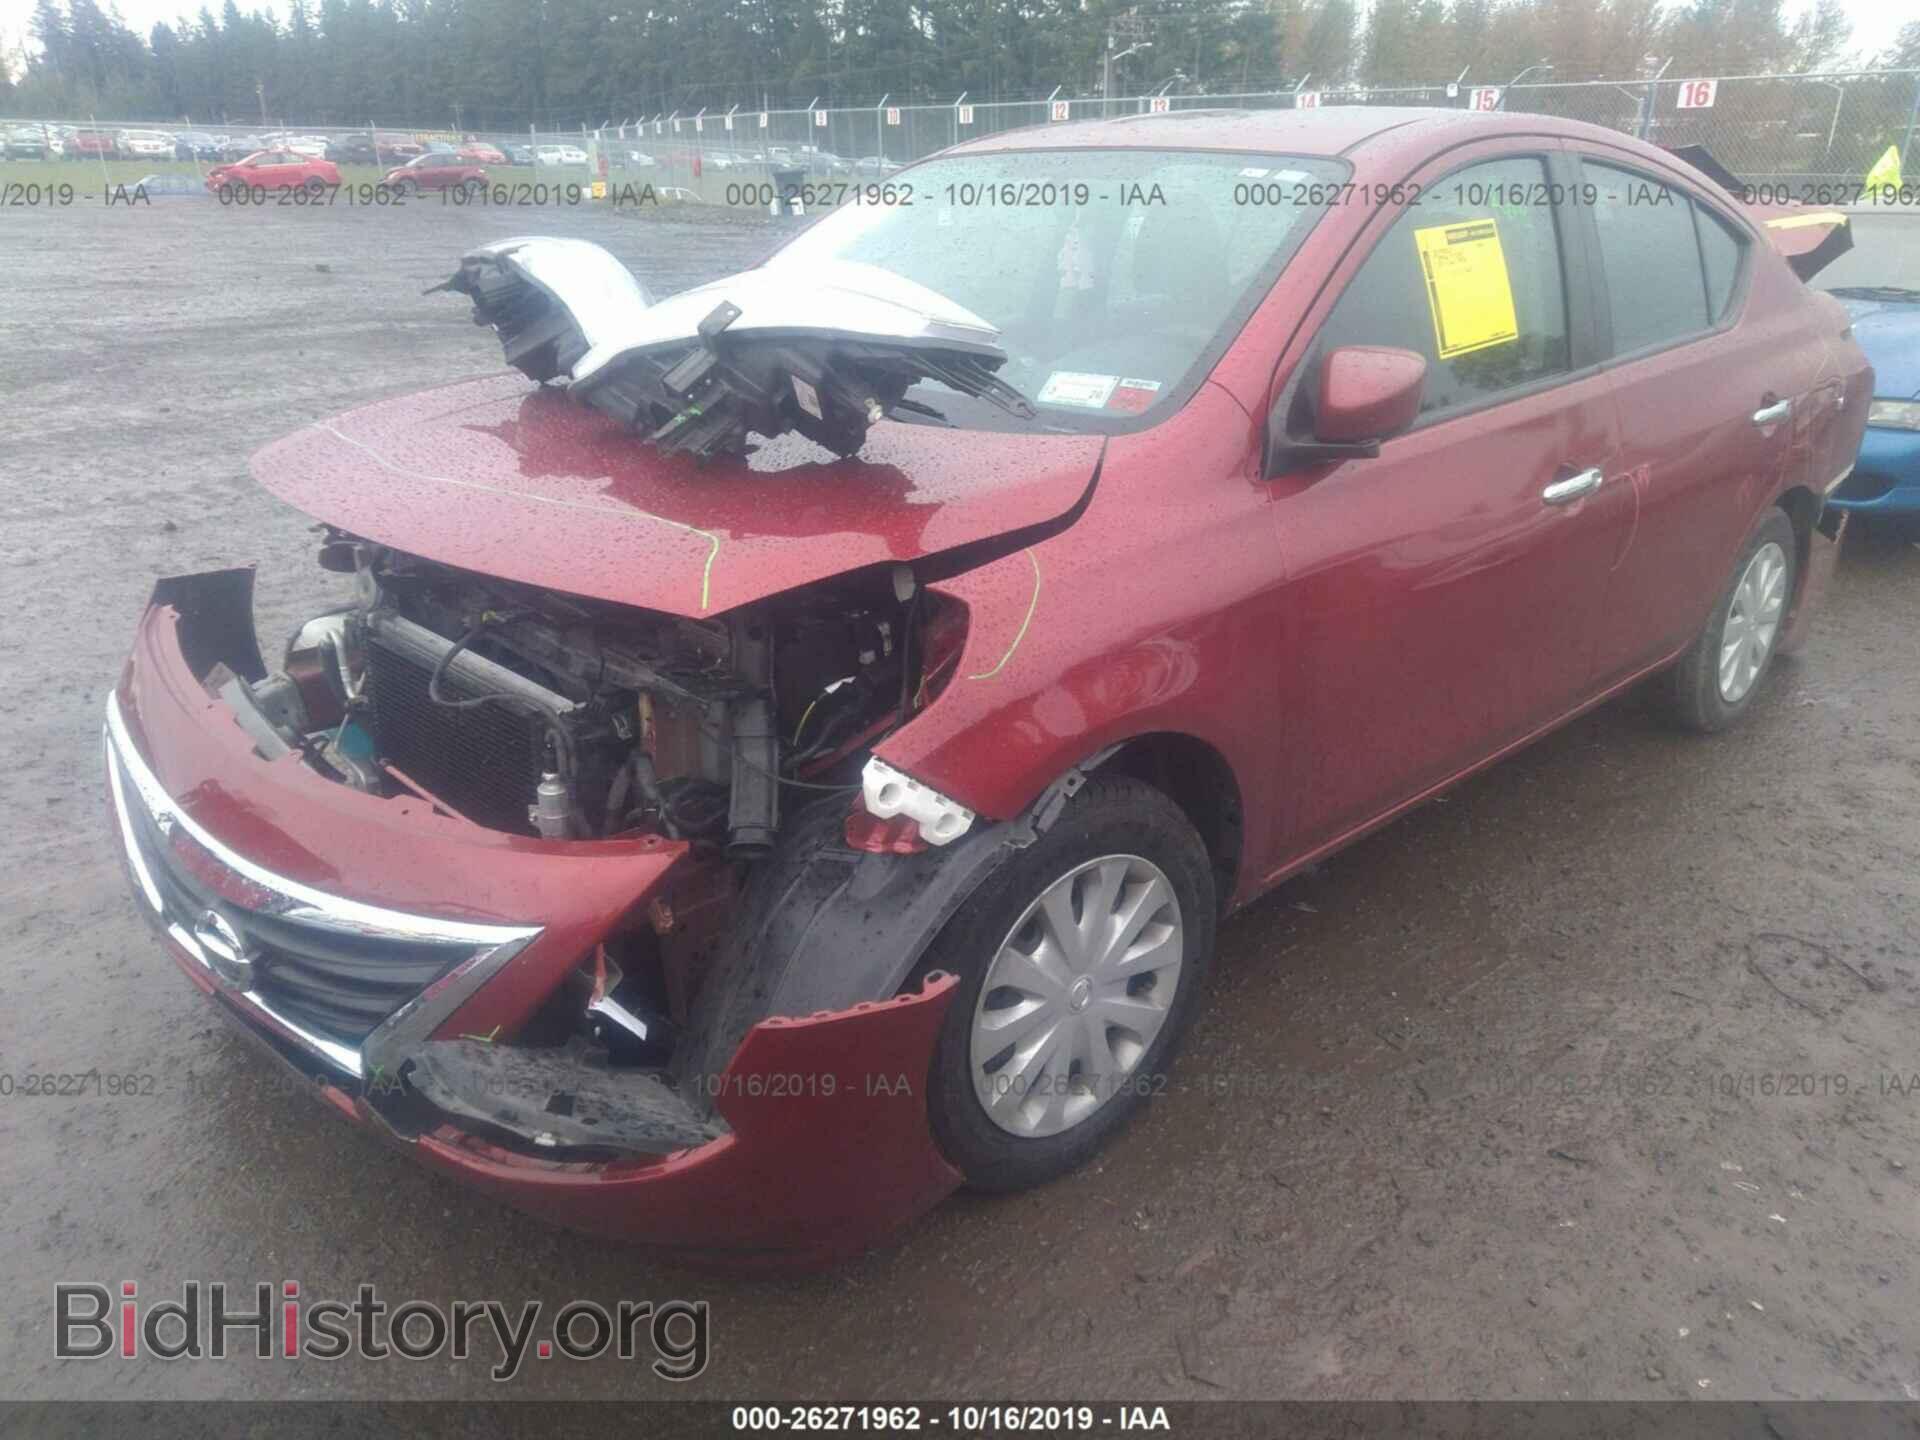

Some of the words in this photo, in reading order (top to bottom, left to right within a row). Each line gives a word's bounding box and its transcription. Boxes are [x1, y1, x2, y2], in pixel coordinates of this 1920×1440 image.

[1300, 94, 1316, 109] 14
[1475, 88, 1496, 111] 15
[1686, 82, 1711, 107] 16
[1056, 103, 1067, 119] 12
